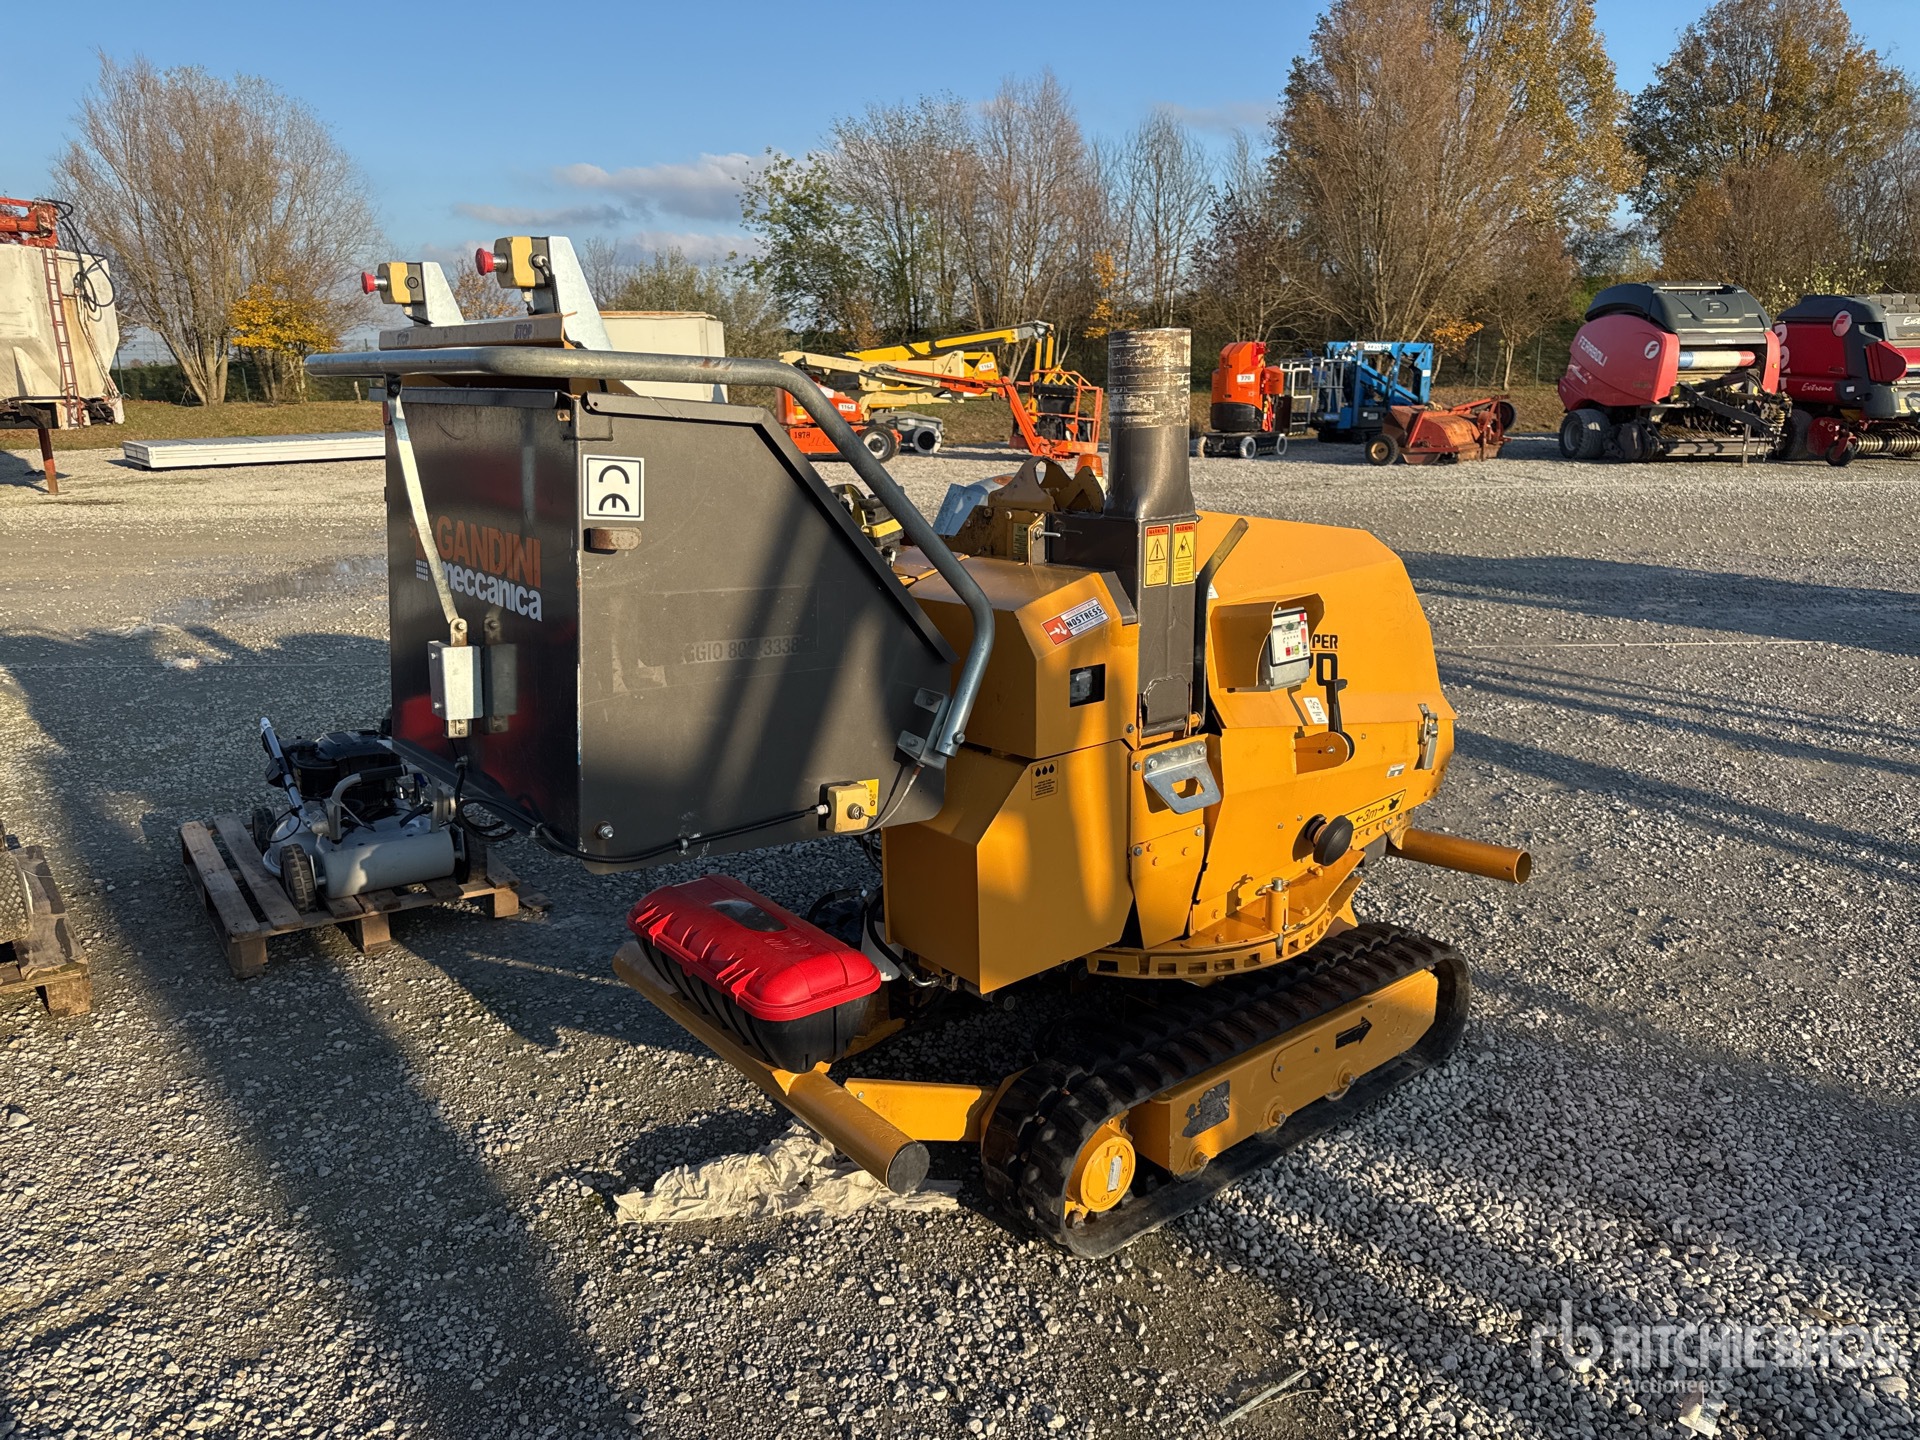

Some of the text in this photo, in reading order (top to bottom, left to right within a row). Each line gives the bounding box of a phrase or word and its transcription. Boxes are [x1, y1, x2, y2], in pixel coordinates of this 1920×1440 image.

[514, 323, 533, 339] STOP
[1801, 382, 1832, 392] Extreme
[436, 515, 542, 588] GANDINI
[440, 561, 542, 622] meccanica
[1065, 605, 1103, 629] NOSTRESS
